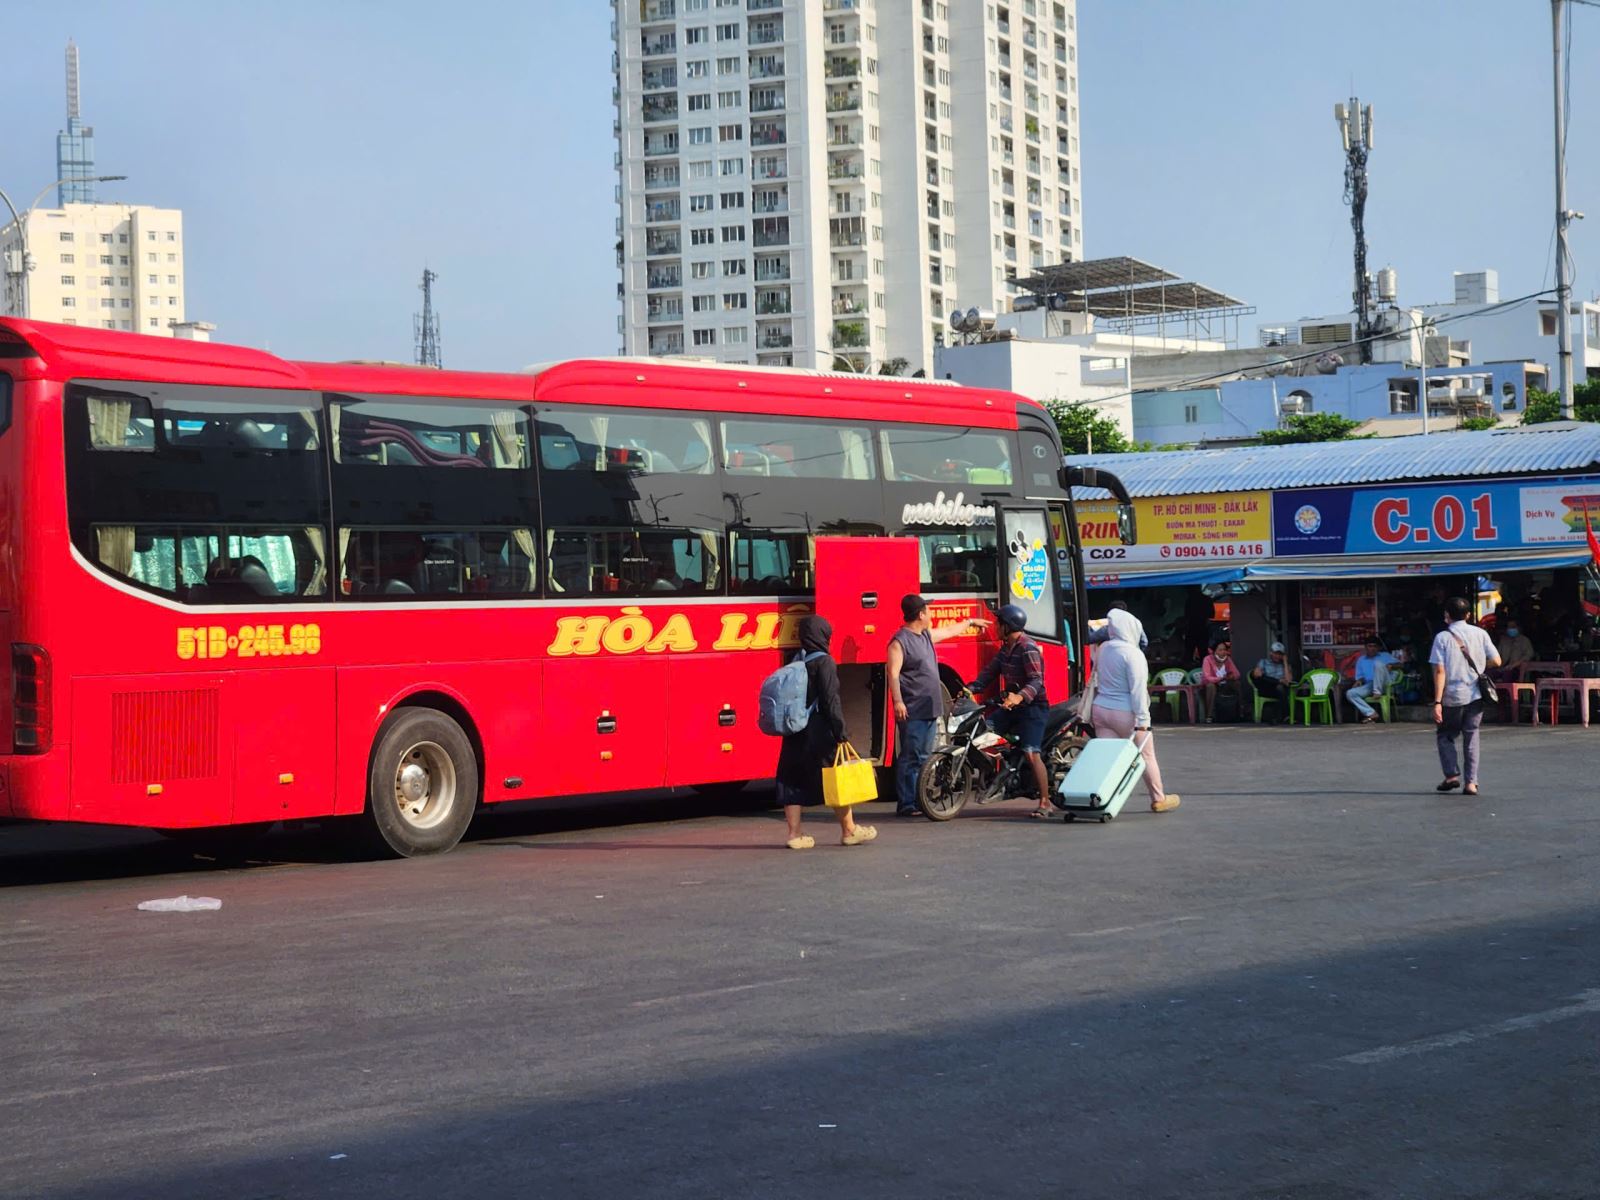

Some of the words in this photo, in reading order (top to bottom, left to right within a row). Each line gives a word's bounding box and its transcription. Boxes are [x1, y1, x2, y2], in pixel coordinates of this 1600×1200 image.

[1153, 505, 1164, 516] TP.
[1195, 503, 1216, 514] MINH
[1526, 510, 1543, 519] Dịch
[1545, 510, 1555, 518] Vụ
[1372, 493, 1498, 545] C.01
[1175, 546, 1206, 557] 0904
[1210, 545, 1234, 556] 416
[1239, 544, 1263, 555] 416
[547, 606, 698, 656] HÒA
[713, 604, 810, 650] LIÊ
